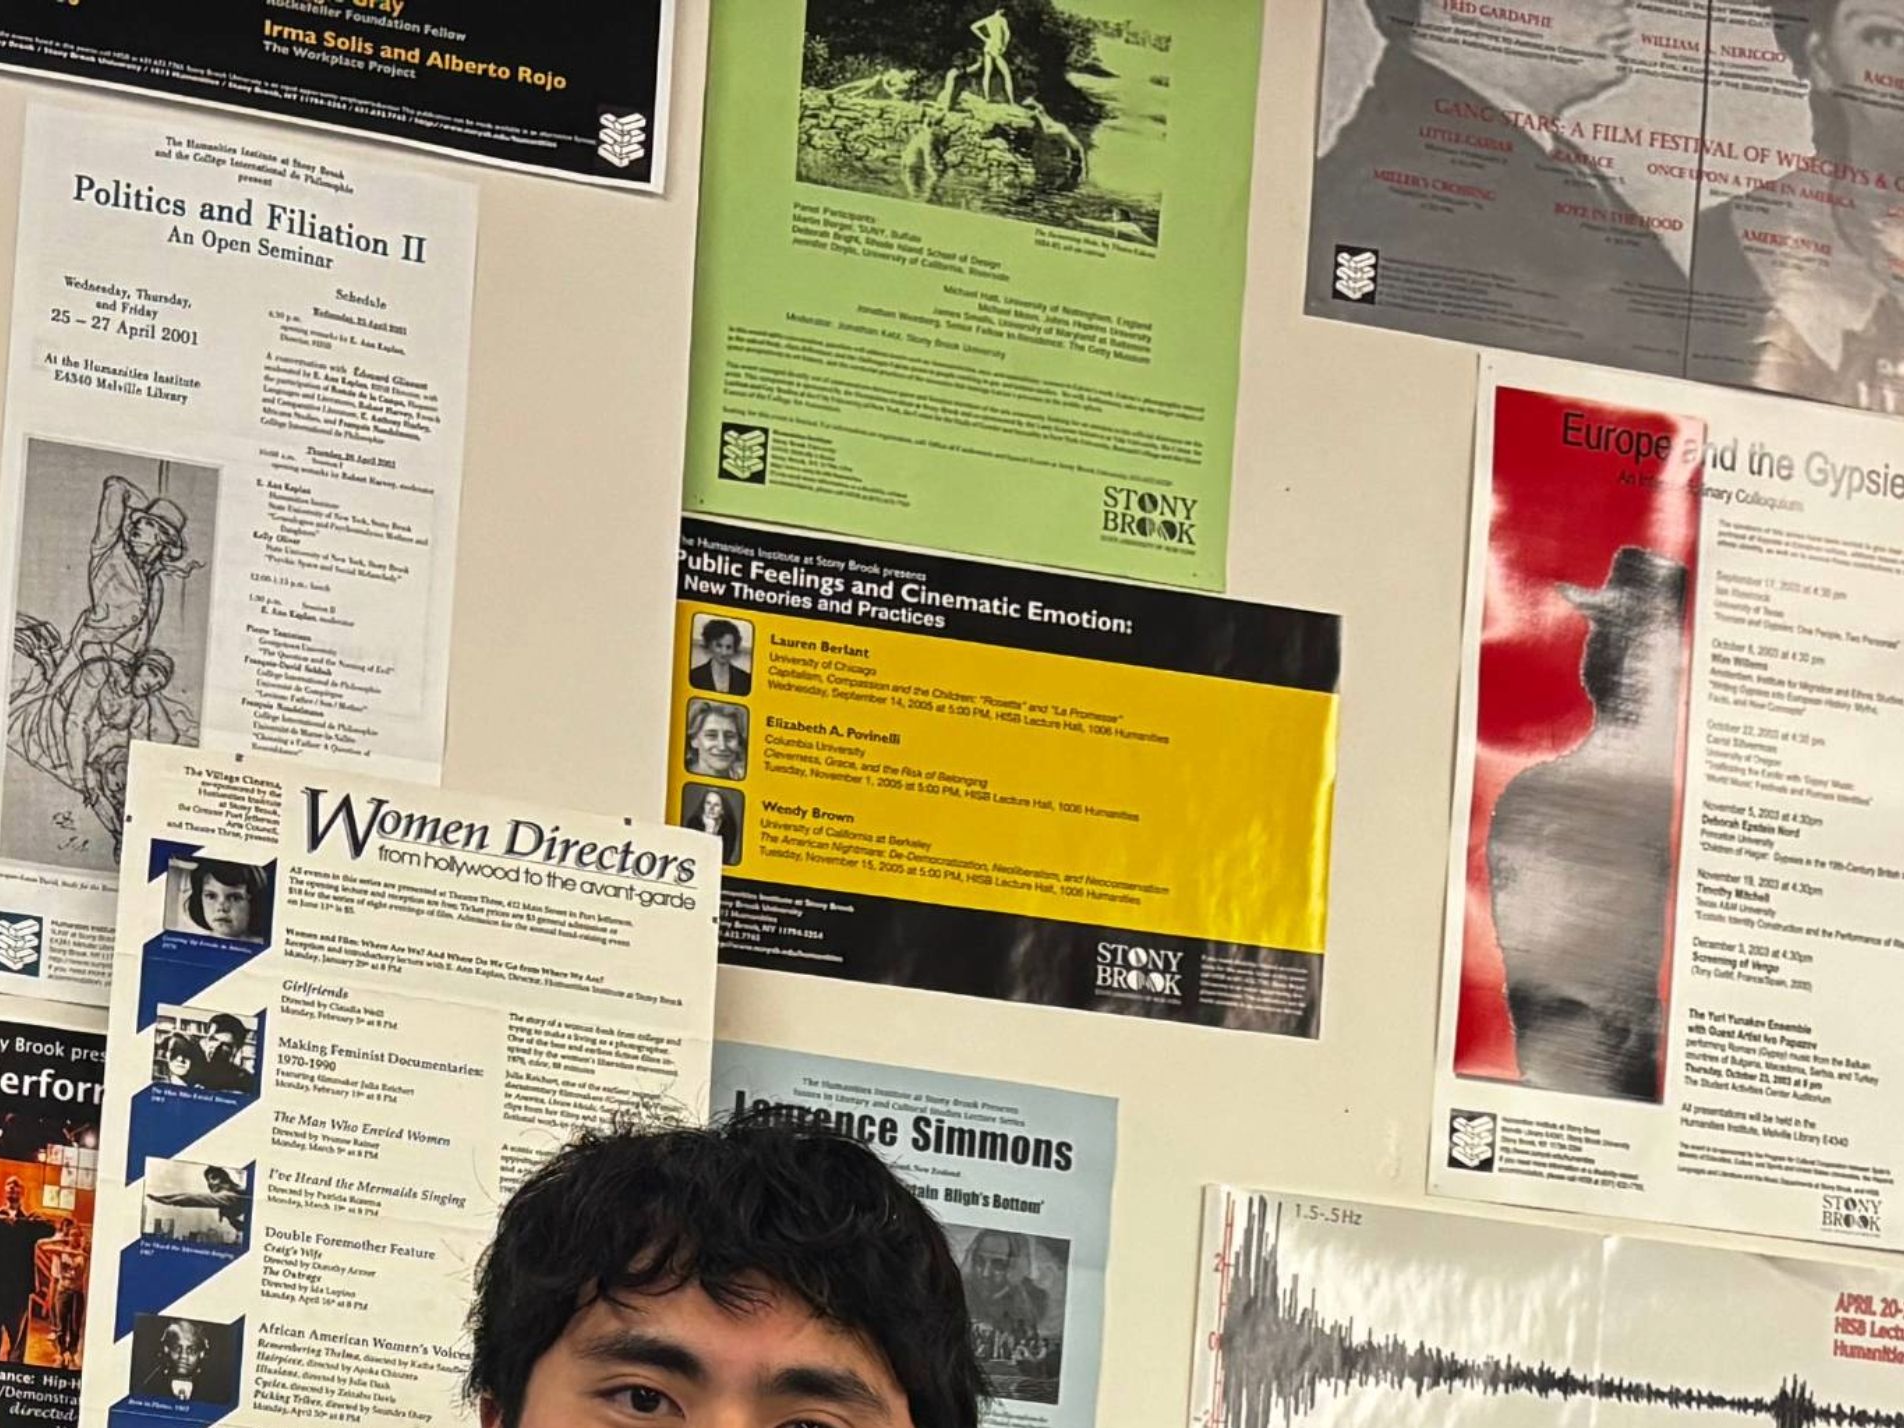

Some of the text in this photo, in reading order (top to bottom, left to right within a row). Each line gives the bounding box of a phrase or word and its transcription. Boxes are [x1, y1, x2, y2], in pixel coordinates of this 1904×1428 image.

[264, 19, 567, 92] Irma Solis and Alberto Rojo
[1435, 100, 1494, 122] GANG
[1499, 110, 1566, 135] STARS:
[1571, 123, 1585, 138] A
[1592, 124, 1642, 148] FILM
[1649, 130, 1739, 162] FESTIVAL
[1744, 145, 1770, 164] OF
[1777, 152, 1869, 187] WISEGUYS
[1875, 173, 1888, 187] &
[73, 174, 426, 264] Politics and Filiation II
[1563, 412, 1671, 467] Europe
[1680, 436, 1736, 472] and
[1748, 444, 1795, 482] the
[676, 549, 1133, 635] Public Feelings and Cinematic Emotion:
[684, 574, 945, 628] New Theories and Practices
[770, 633, 870, 659] Lauren Berlant
[300, 786, 697, 885] Women Directors
[761, 800, 855, 823] Wendy Brown
[378, 844, 697, 911] from hollywood to the avant-garde
[911, 1110, 1073, 1172] Simmons
